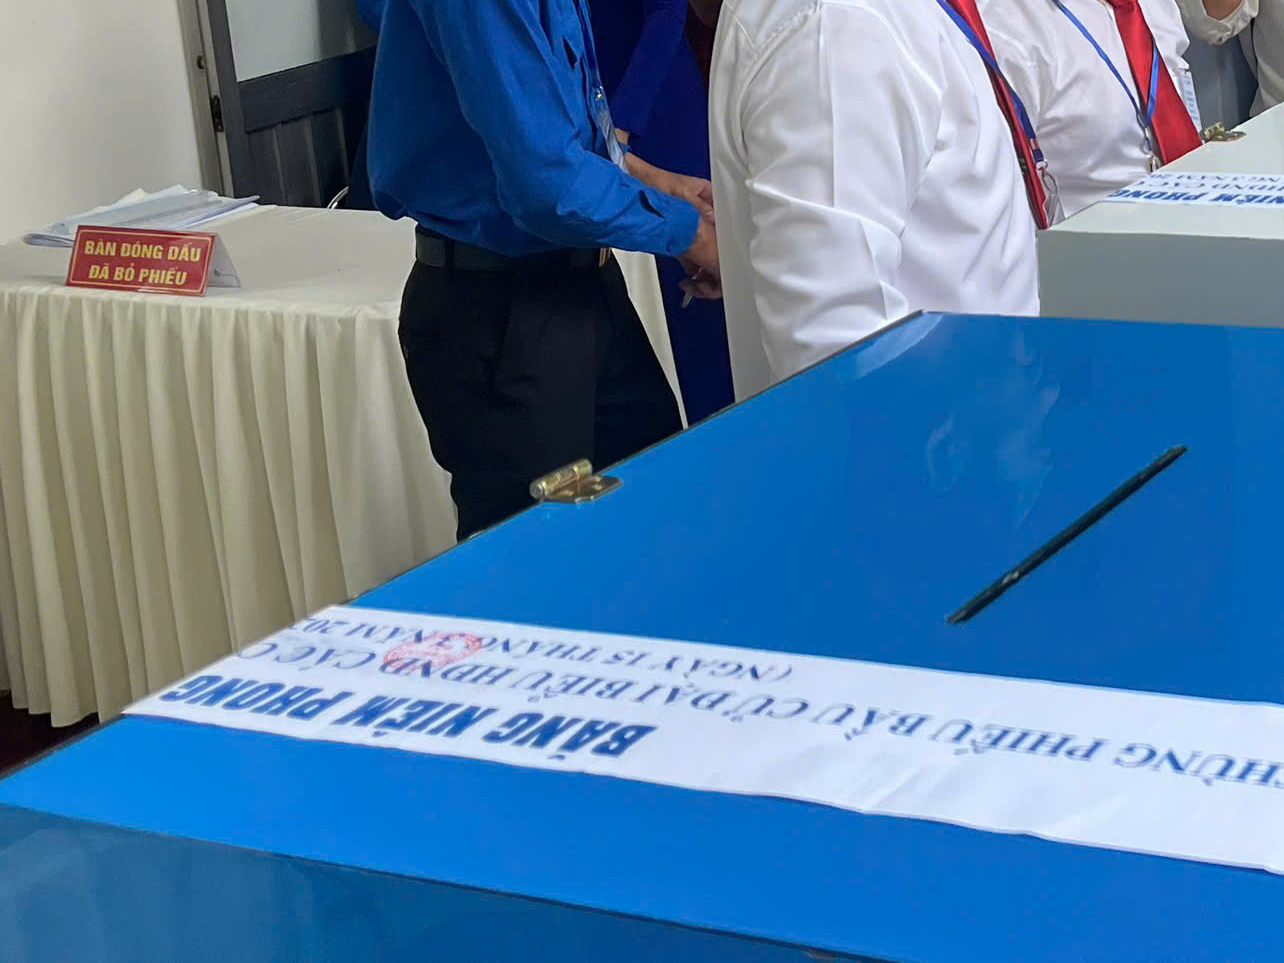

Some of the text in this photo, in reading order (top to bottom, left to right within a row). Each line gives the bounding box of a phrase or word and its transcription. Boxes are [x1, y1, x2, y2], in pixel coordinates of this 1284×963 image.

[84, 239, 202, 262] BÀN ĐÓNG DẤU
[88, 262, 188, 286] ĐÃ BỎ PHIẾU
[275, 644, 377, 671] CÁC
[603, 648, 651, 666] 15
[379, 657, 515, 686] HĐND
[634, 682, 738, 711] ĐẠI
[158, 674, 658, 760] BĂNG NIÊM PHONG
[926, 718, 1109, 763] PHIẾU
